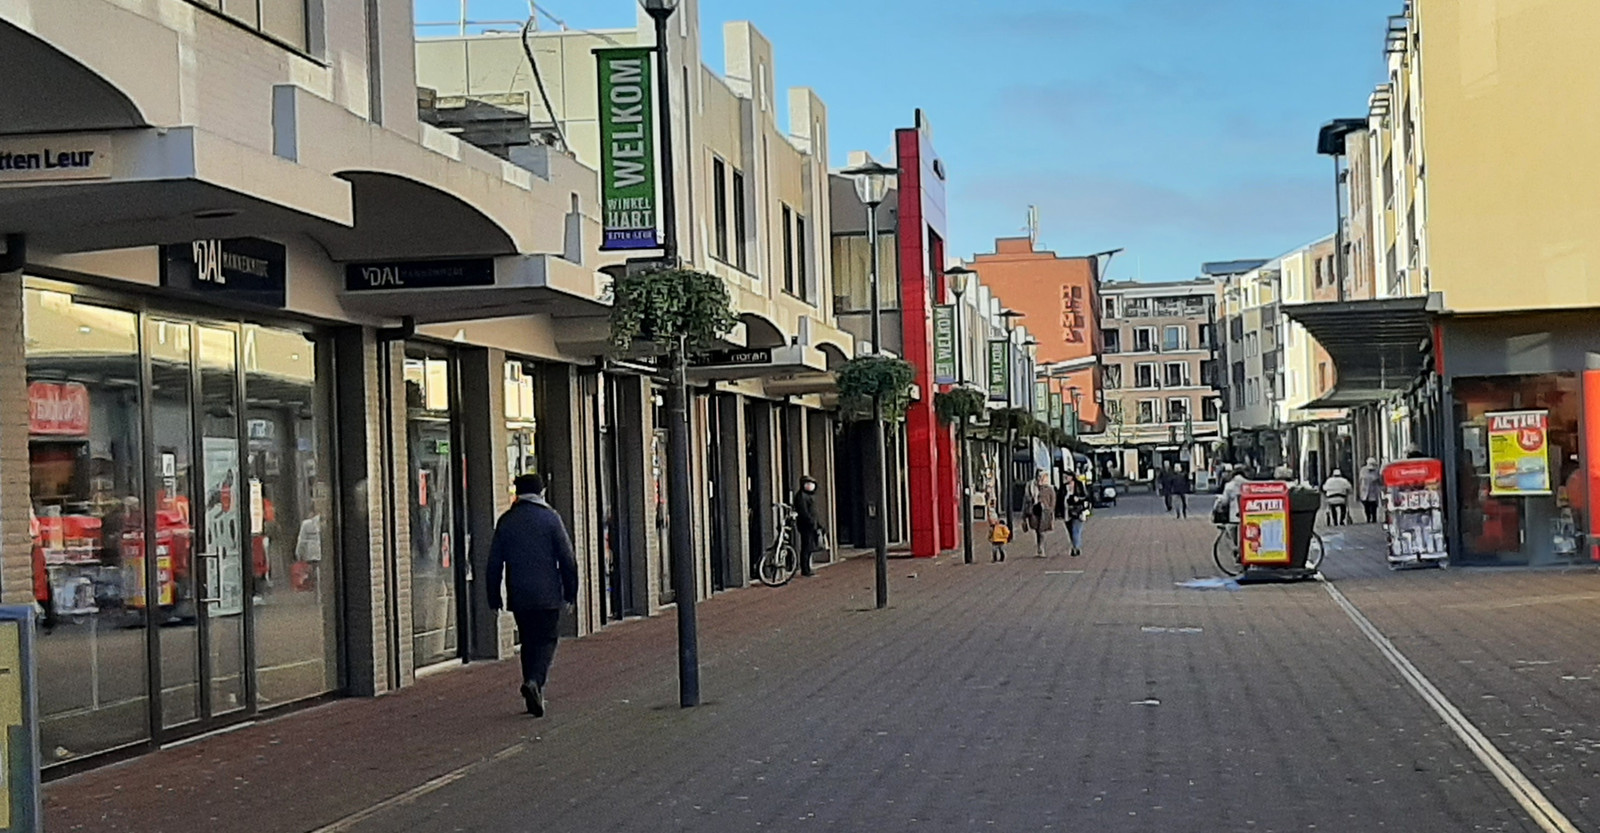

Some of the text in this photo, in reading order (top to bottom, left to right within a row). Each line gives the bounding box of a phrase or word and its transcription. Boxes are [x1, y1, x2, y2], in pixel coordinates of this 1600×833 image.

[609, 58, 646, 189] WELKOM
[44, 148, 94, 169] Leur
[607, 197, 652, 210] WINKEL
[608, 210, 652, 229] HART
[1062, 284, 1085, 344] HEMA
